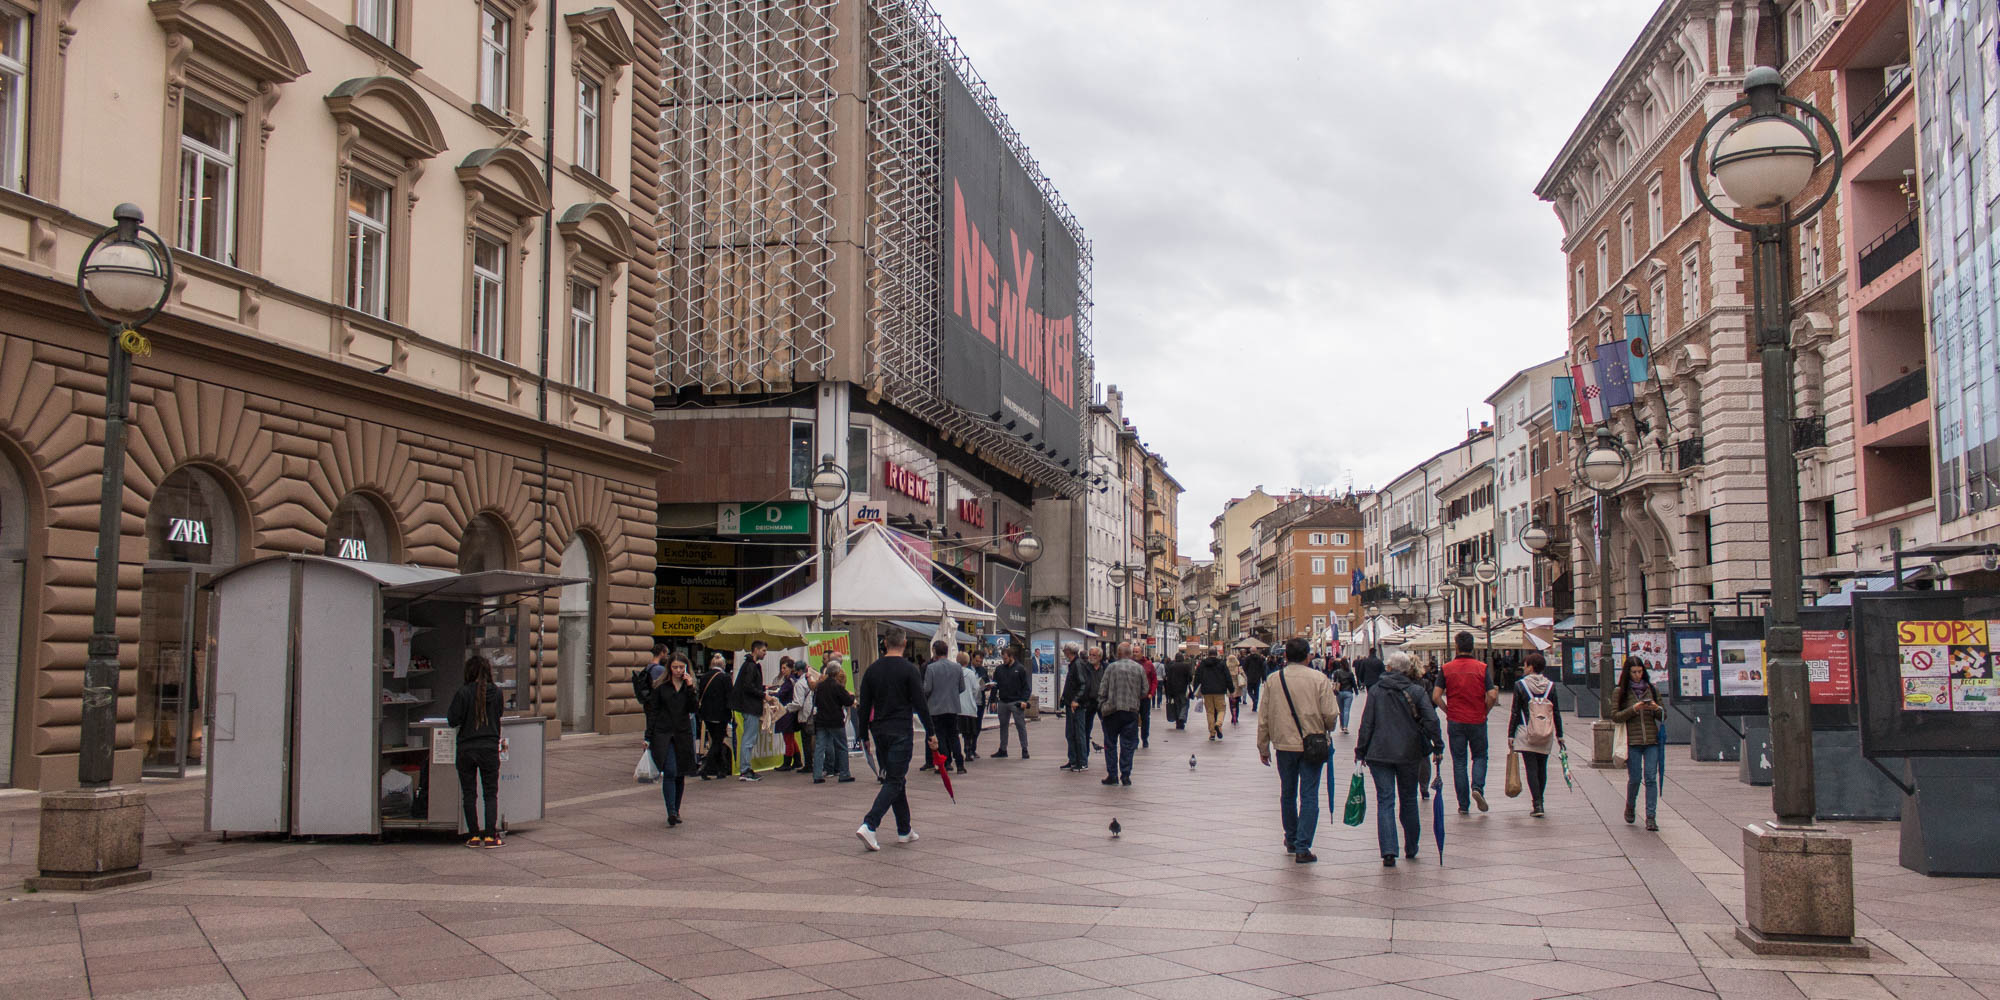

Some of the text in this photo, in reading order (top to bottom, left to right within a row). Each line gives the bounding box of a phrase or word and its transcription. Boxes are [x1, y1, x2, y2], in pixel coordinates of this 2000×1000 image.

[953, 176, 1018, 360] NEW
[1010, 228, 1074, 410] YORKER
[886, 461, 931, 505] ROBNA
[766, 506, 782, 523] D
[858, 505, 880, 520] dm
[167, 517, 209, 544] ZARA
[338, 538, 368, 561] ZARA
[680, 576, 728, 586] bankomat
[680, 616, 704, 624] Money
[1898, 620, 1965, 644] STOP
[808, 634, 850, 657] MOŽEMO!
